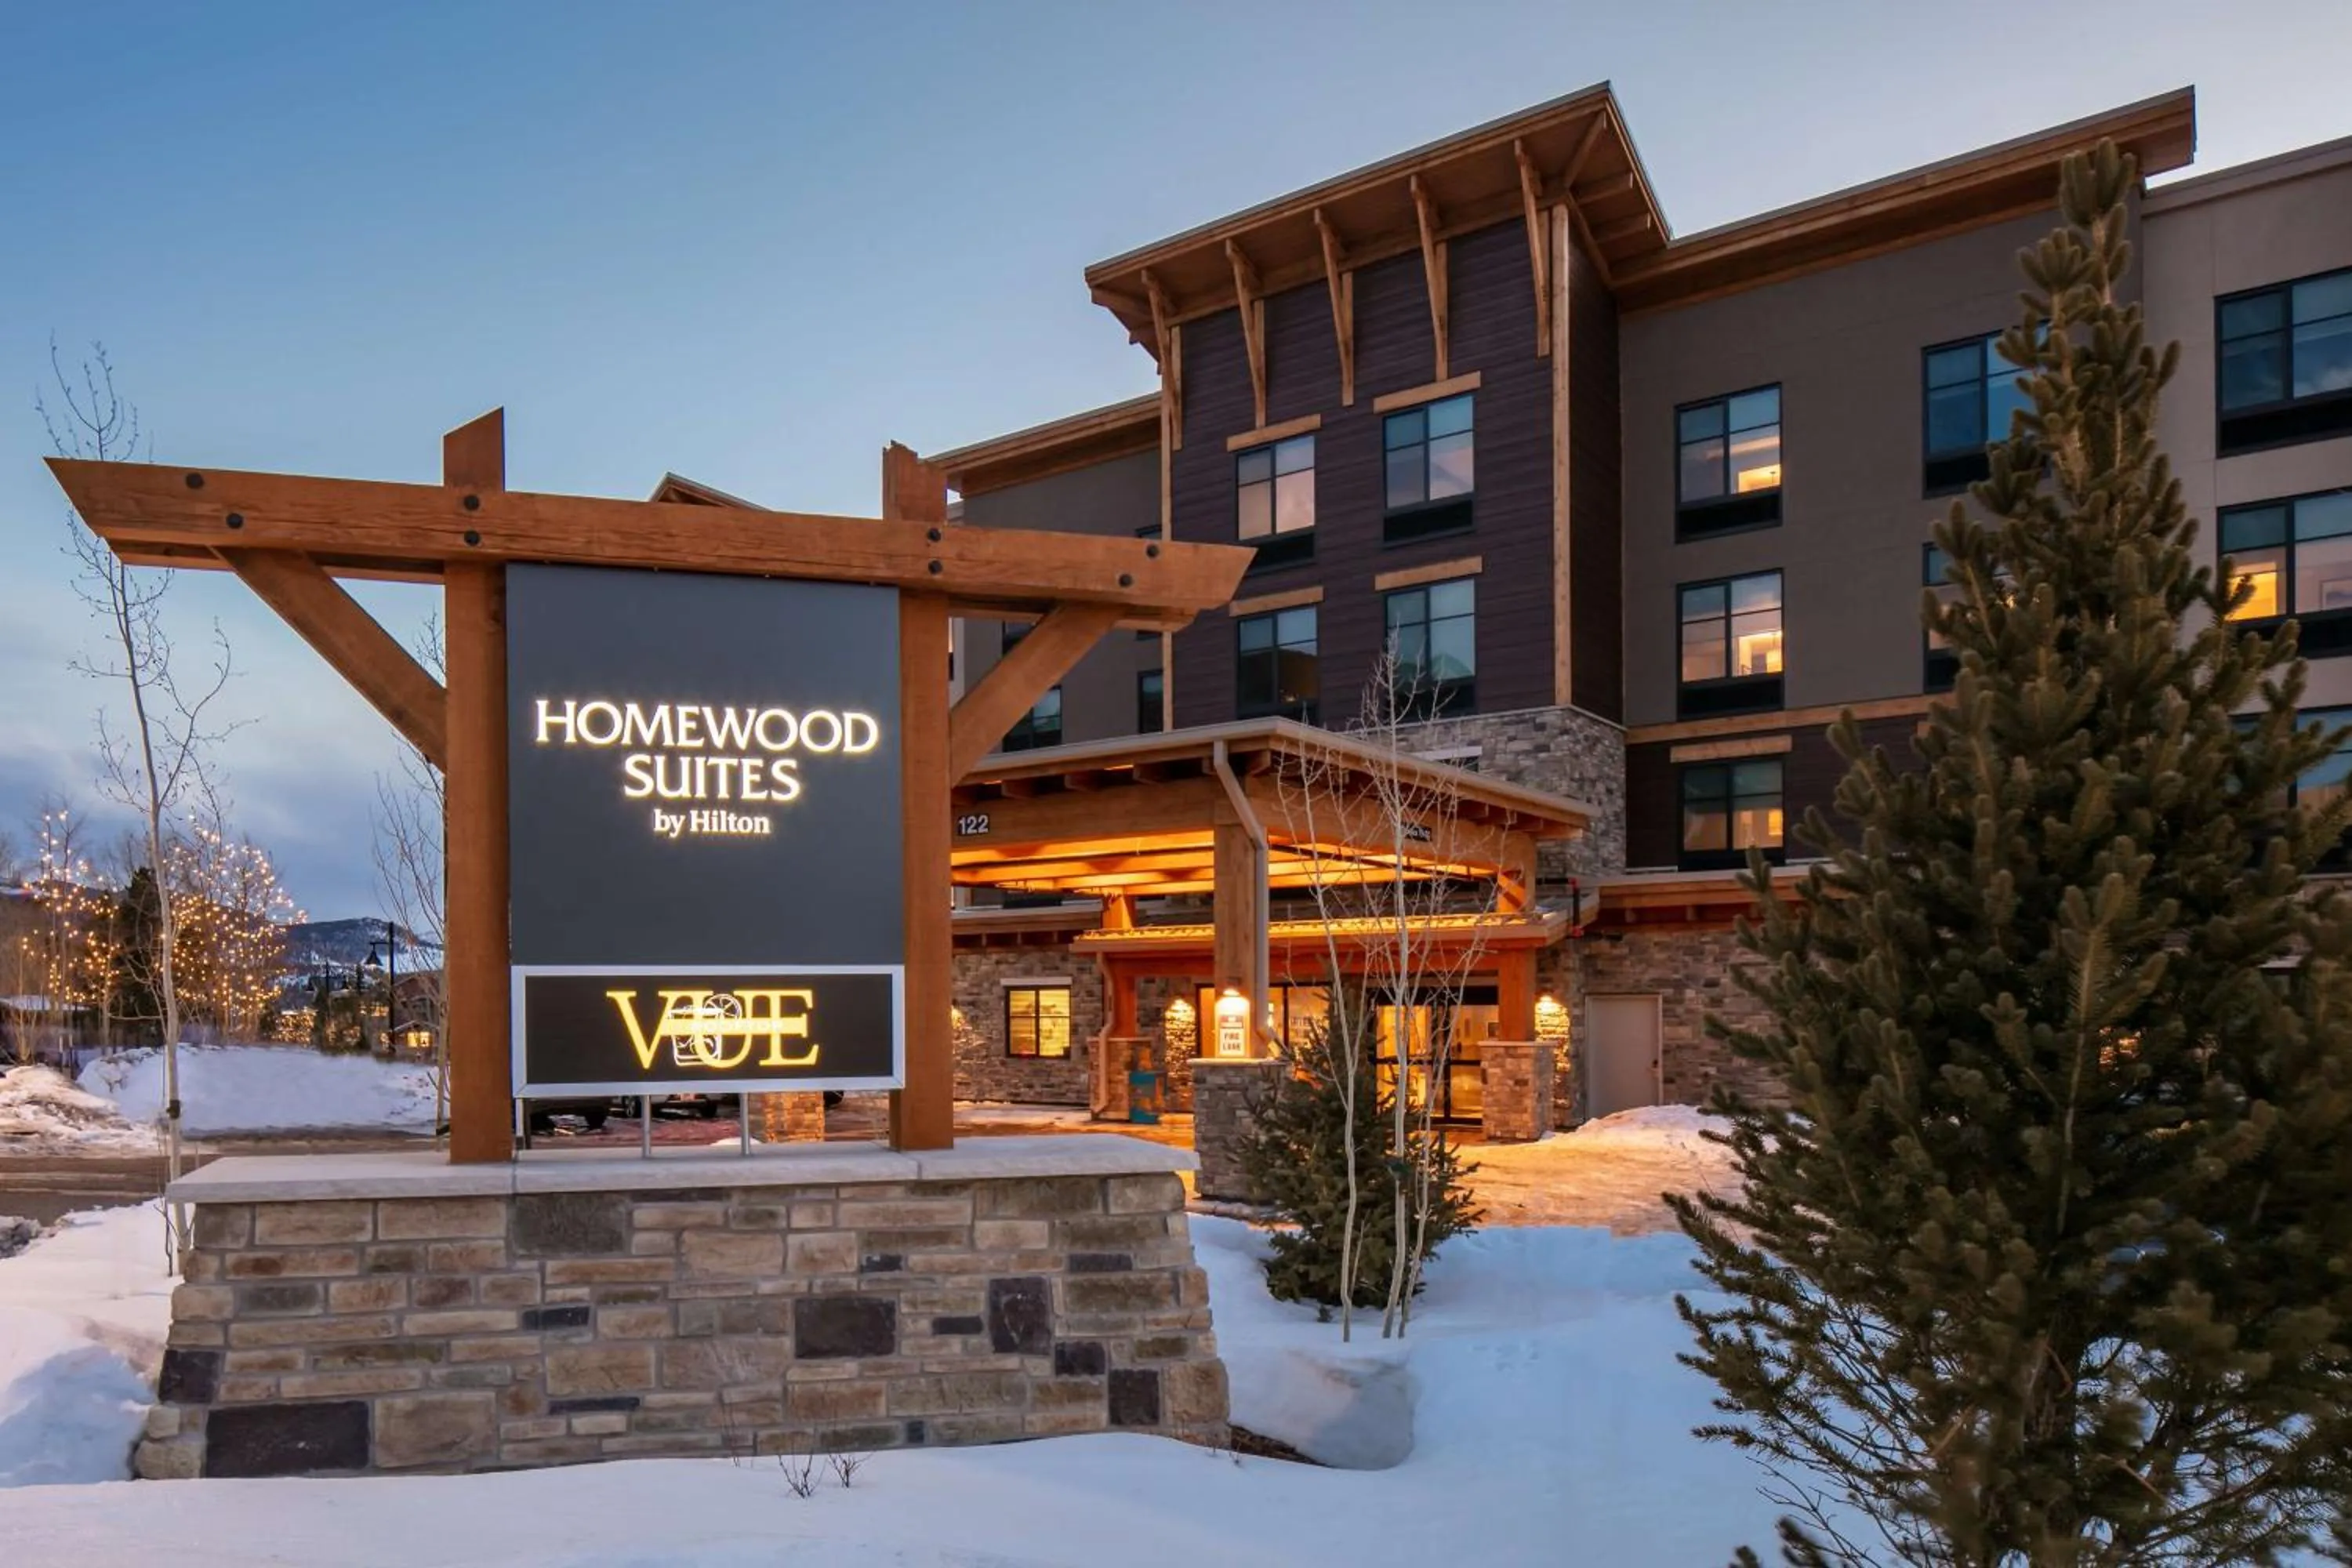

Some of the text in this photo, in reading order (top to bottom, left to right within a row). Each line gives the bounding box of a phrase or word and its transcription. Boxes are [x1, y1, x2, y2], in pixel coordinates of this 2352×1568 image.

[535, 699, 880, 754] HOMEWOOD
[623, 753, 801, 802] SUITES
[653, 808, 771, 838] by Hilton
[959, 815, 989, 835] 122
[606, 989, 819, 1069] VUE
